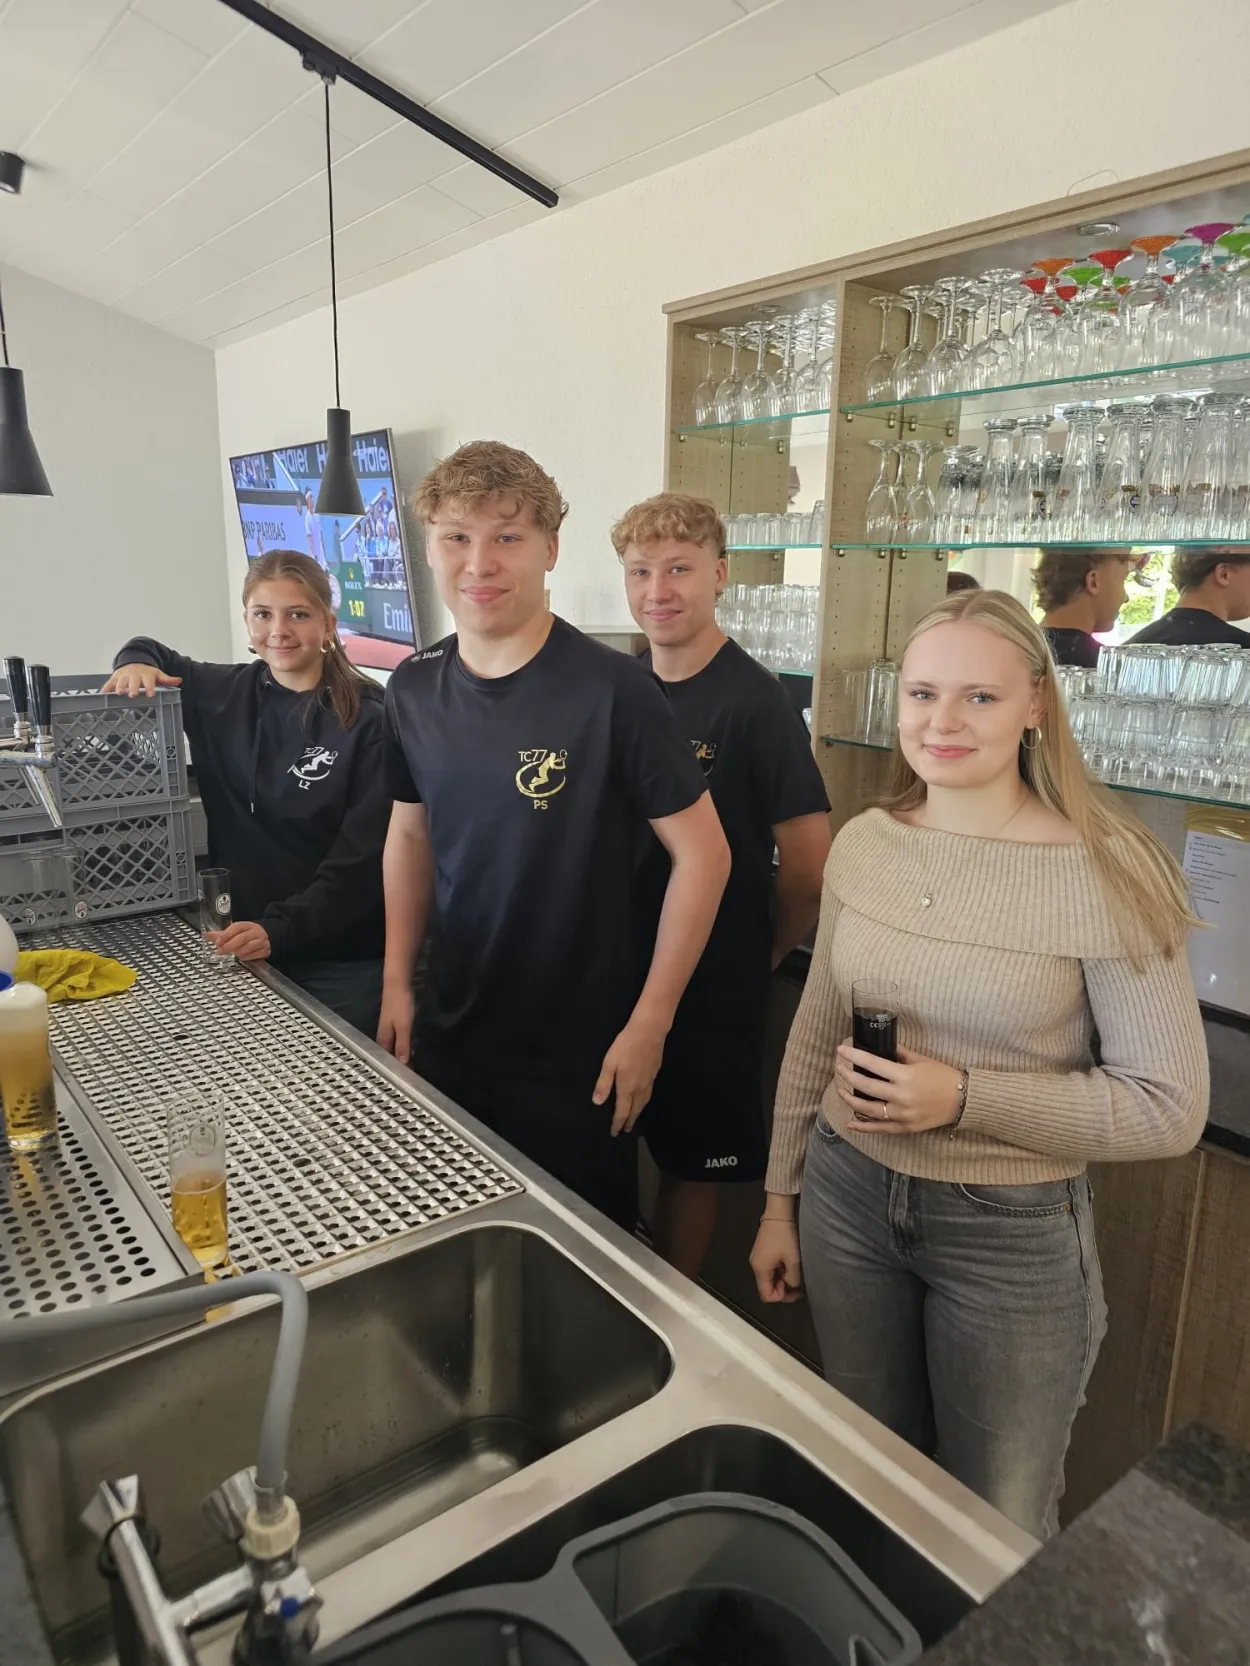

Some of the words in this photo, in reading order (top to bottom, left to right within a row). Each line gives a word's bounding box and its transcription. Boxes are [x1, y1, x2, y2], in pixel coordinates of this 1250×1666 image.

[256, 521, 286, 542] PARIBAS
[421, 649, 444, 660] JAKO
[518, 749, 548, 762] TC77
[298, 779, 310, 790] LZ
[533, 799, 549, 810] PS
[704, 1155, 739, 1168] JAKO
